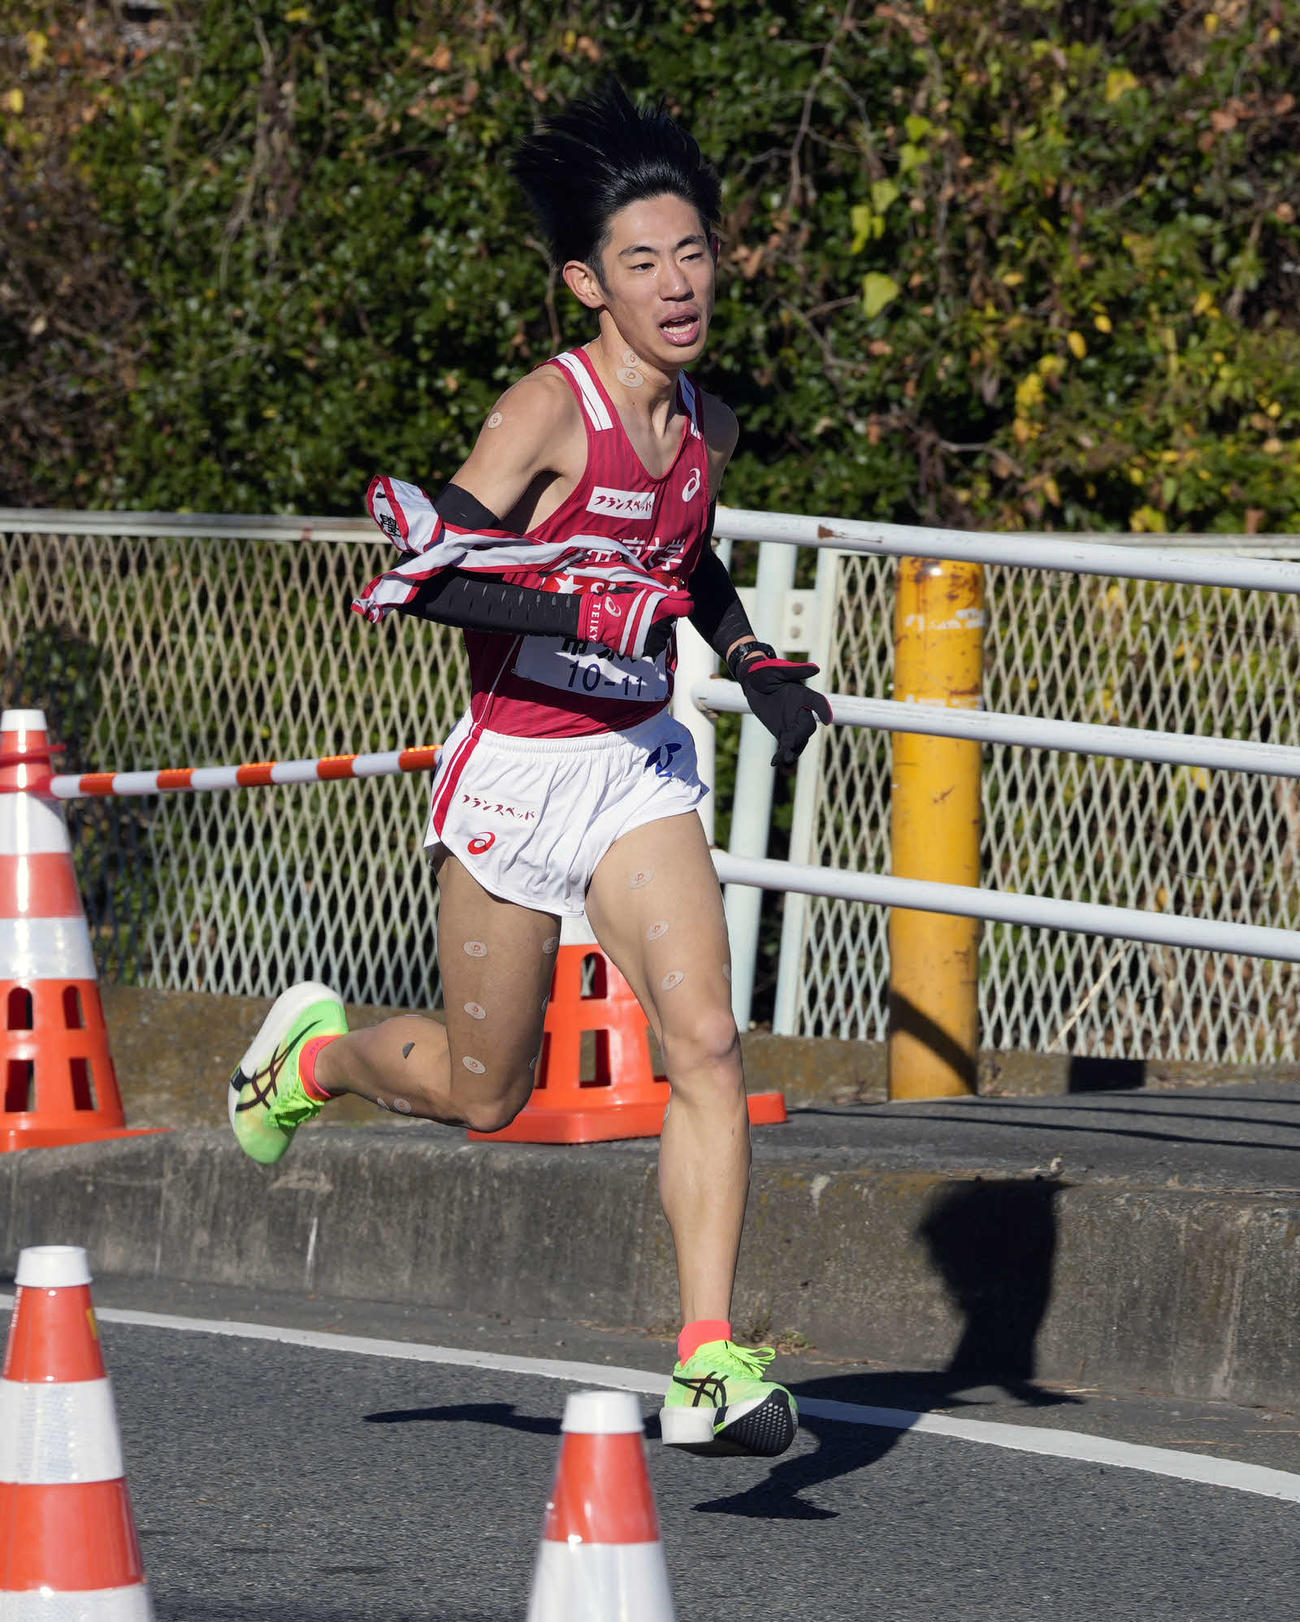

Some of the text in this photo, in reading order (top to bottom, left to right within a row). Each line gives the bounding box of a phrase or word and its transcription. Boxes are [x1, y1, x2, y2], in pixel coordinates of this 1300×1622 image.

[567, 660, 643, 697] 10-11
[463, 794, 535, 820] フランスベッド
